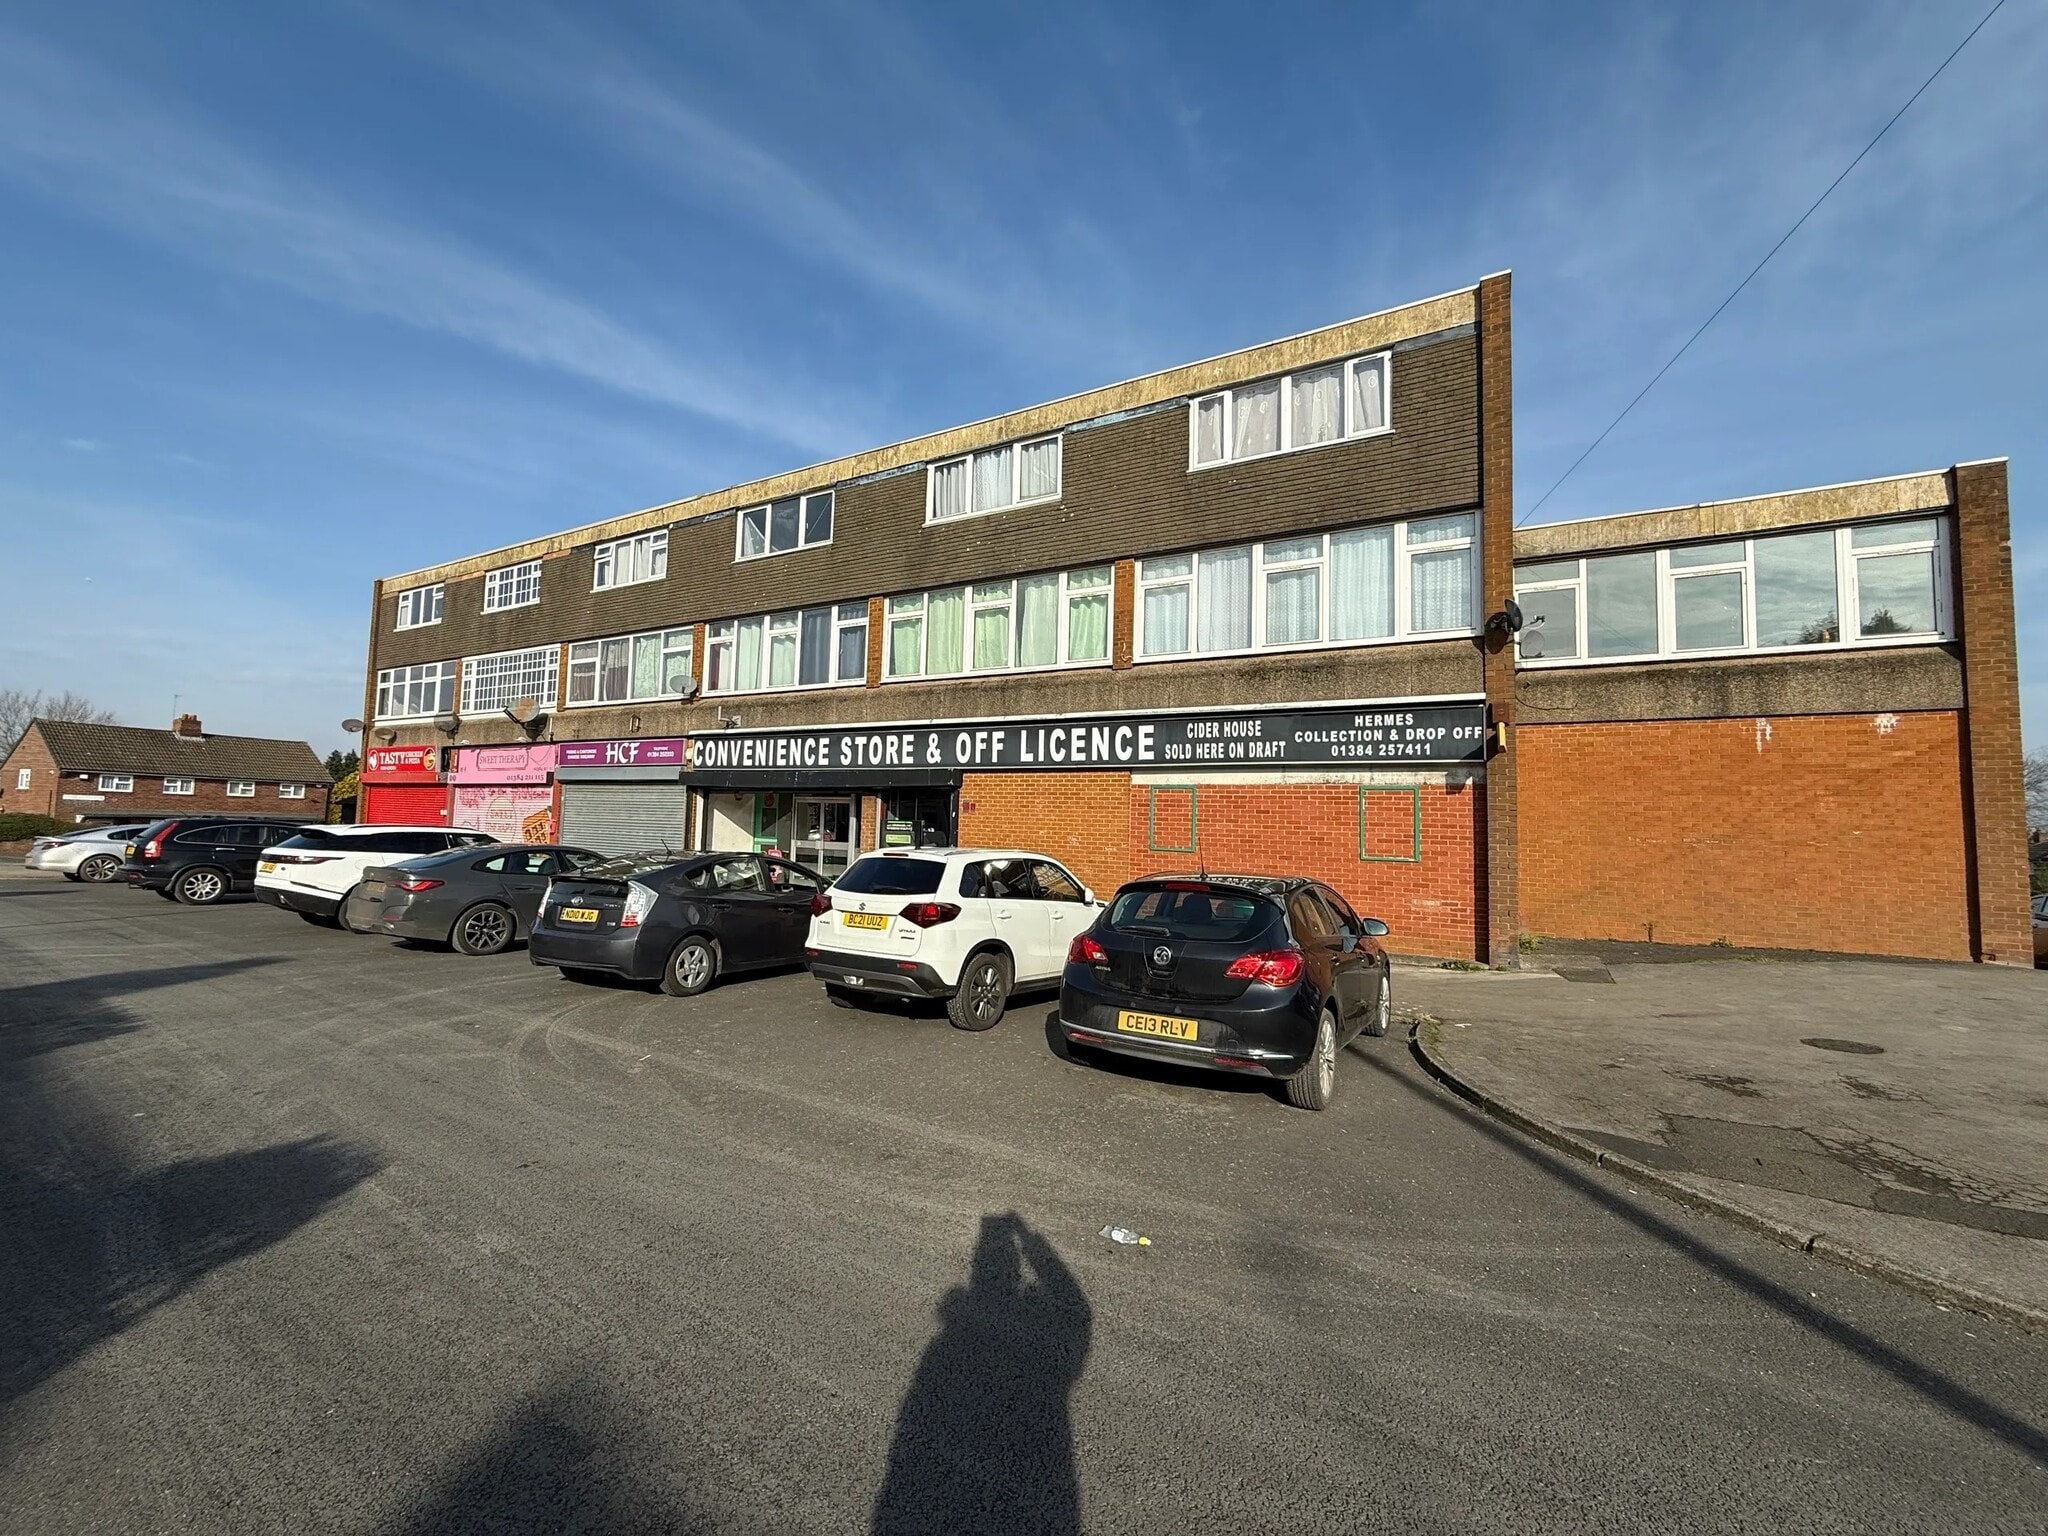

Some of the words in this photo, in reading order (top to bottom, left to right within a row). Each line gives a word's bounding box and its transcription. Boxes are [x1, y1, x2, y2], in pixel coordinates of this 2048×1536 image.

[1187, 721, 1220, 739] CIDER
[1223, 720, 1262, 737] HOUSE
[1354, 714, 1414, 727] HERMES
[1294, 729, 1382, 744] COLLECTION
[1389, 729, 1400, 741] &
[1406, 728, 1446, 740] DROP
[1453, 726, 1483, 739] OFF
[606, 742, 640, 764] HCF
[693, 737, 830, 767] CONVENIENCE
[840, 734, 915, 766] STORE
[926, 733, 942, 764] &
[955, 731, 1005, 763] OFF
[1020, 725, 1156, 763] LICENCE
[1164, 743, 1192, 759] SOLD
[1196, 742, 1224, 759] HERE
[1228, 742, 1245, 758] ON
[1248, 740, 1286, 758] DRAFT
[1331, 744, 1373, 757] 01384
[1378, 743, 1432, 756] 257411
[380, 752, 405, 764] TASTY
[479, 755, 497, 764] SWEET
[498, 753, 525, 764] THERAPY
[848, 914, 865, 925] BC21
[867, 916, 883, 927] UUZ
[1126, 1014, 1156, 1032] CE13
